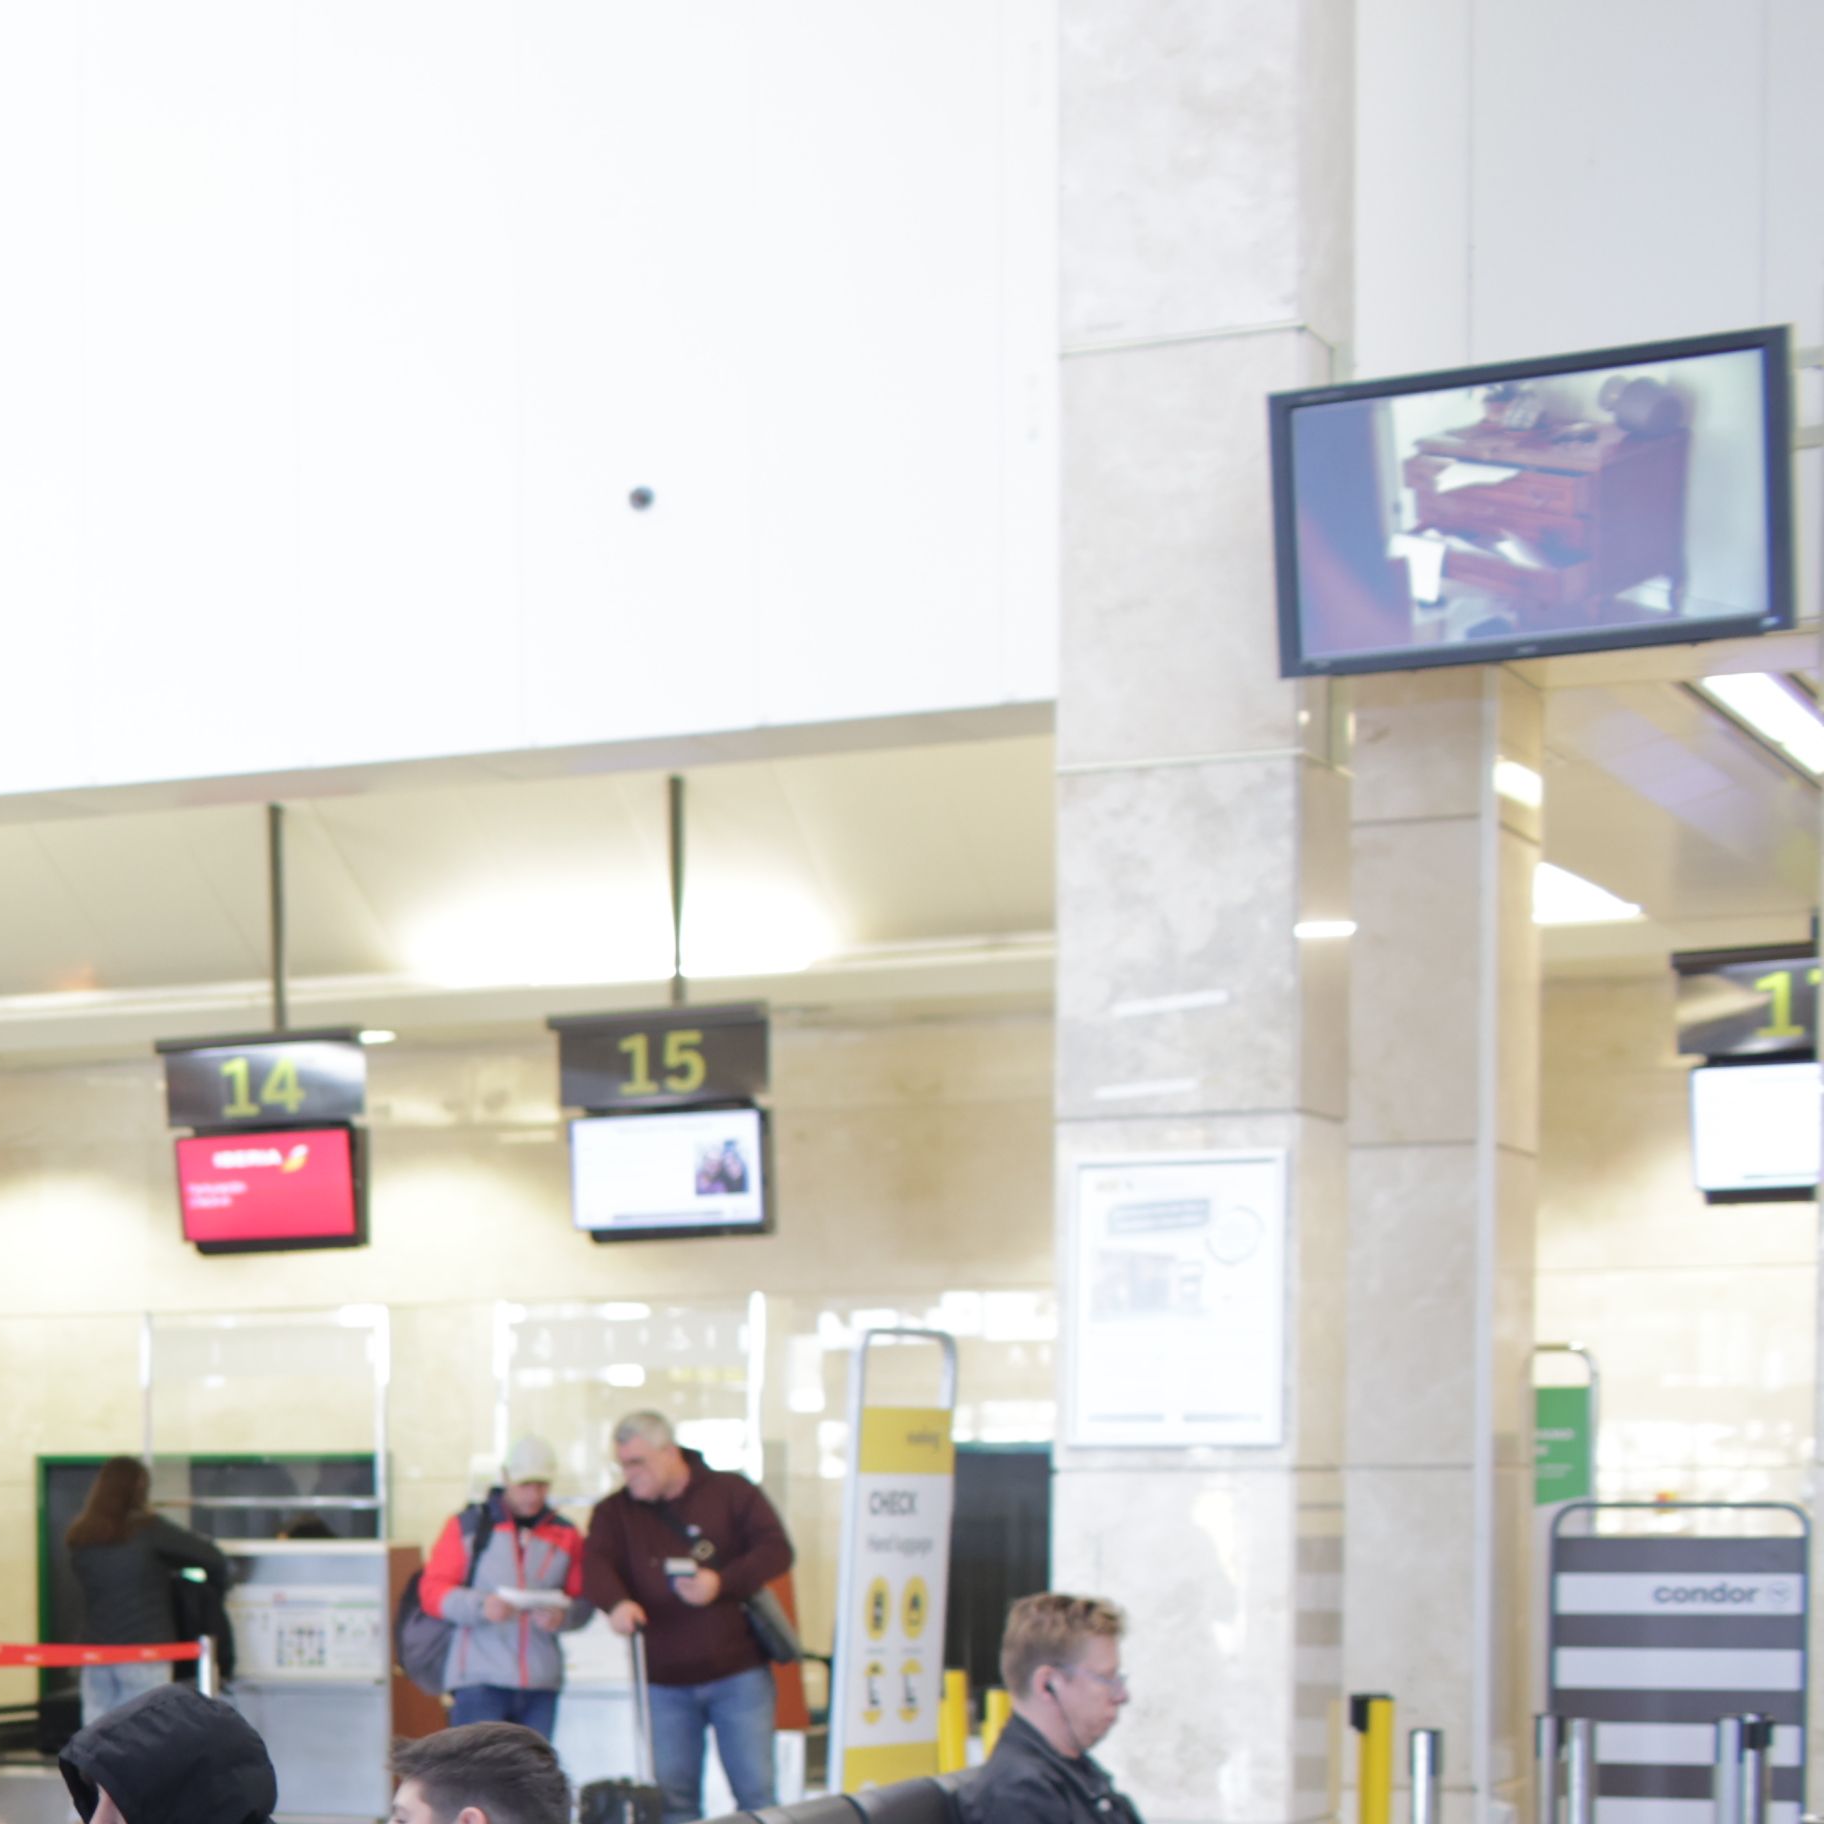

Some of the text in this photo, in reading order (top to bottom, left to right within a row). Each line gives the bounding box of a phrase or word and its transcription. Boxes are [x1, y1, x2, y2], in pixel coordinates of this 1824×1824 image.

[1754, 967, 1822, 1037] 1
[219, 1055, 307, 1119] 14
[617, 1030, 707, 1096] 15
[869, 1490, 918, 1516] CHECK
[1653, 1582, 1759, 1606] condor
